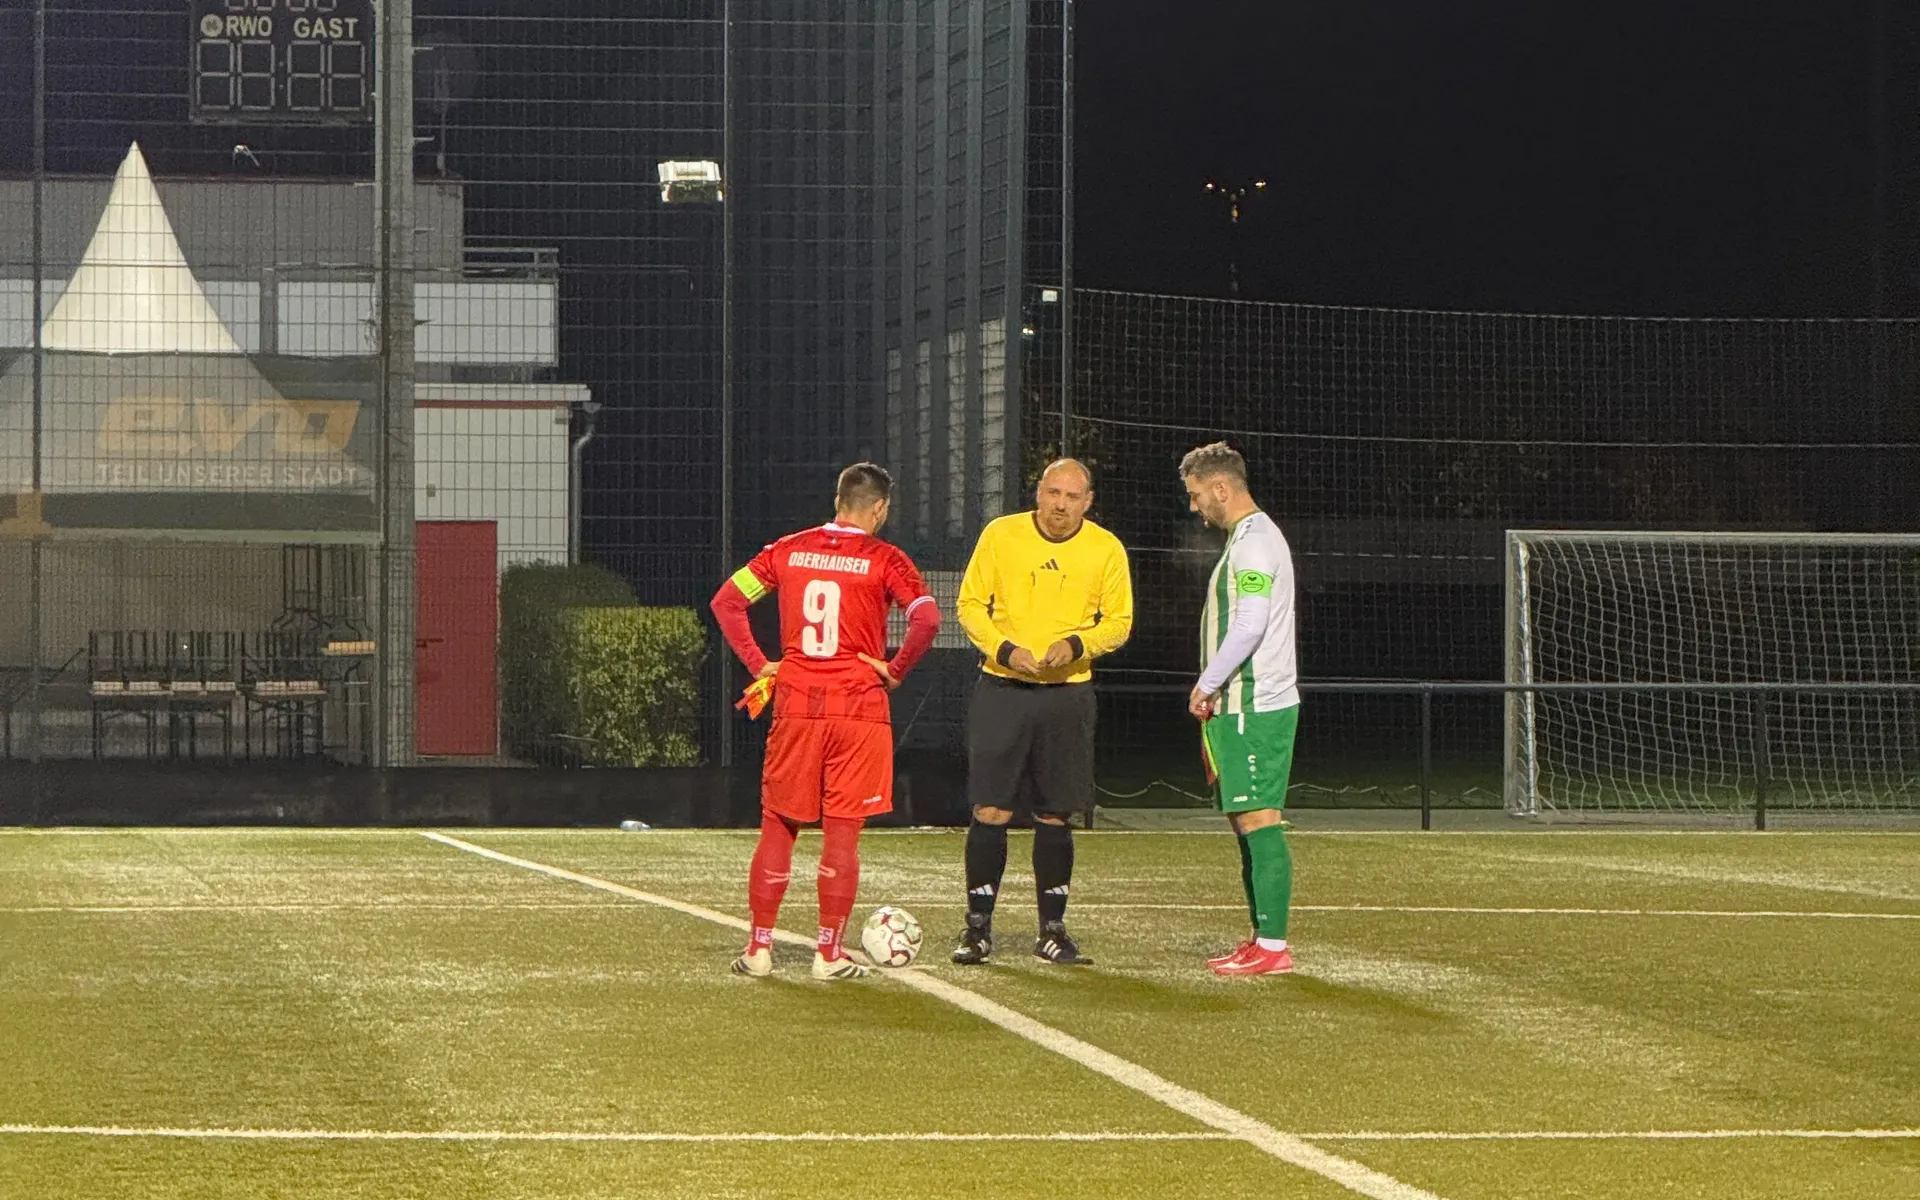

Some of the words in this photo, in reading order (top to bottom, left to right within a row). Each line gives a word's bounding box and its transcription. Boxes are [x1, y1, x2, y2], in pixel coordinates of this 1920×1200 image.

[226, 15, 272, 37] RWO
[293, 17, 359, 38] GAST
[96, 397, 361, 454] evo
[97, 464, 149, 483] TEIL
[159, 465, 272, 483] UNSERER
[283, 466, 357, 485] STADT
[788, 552, 871, 575] OBERHAUSEN
[802, 579, 841, 657] 9
